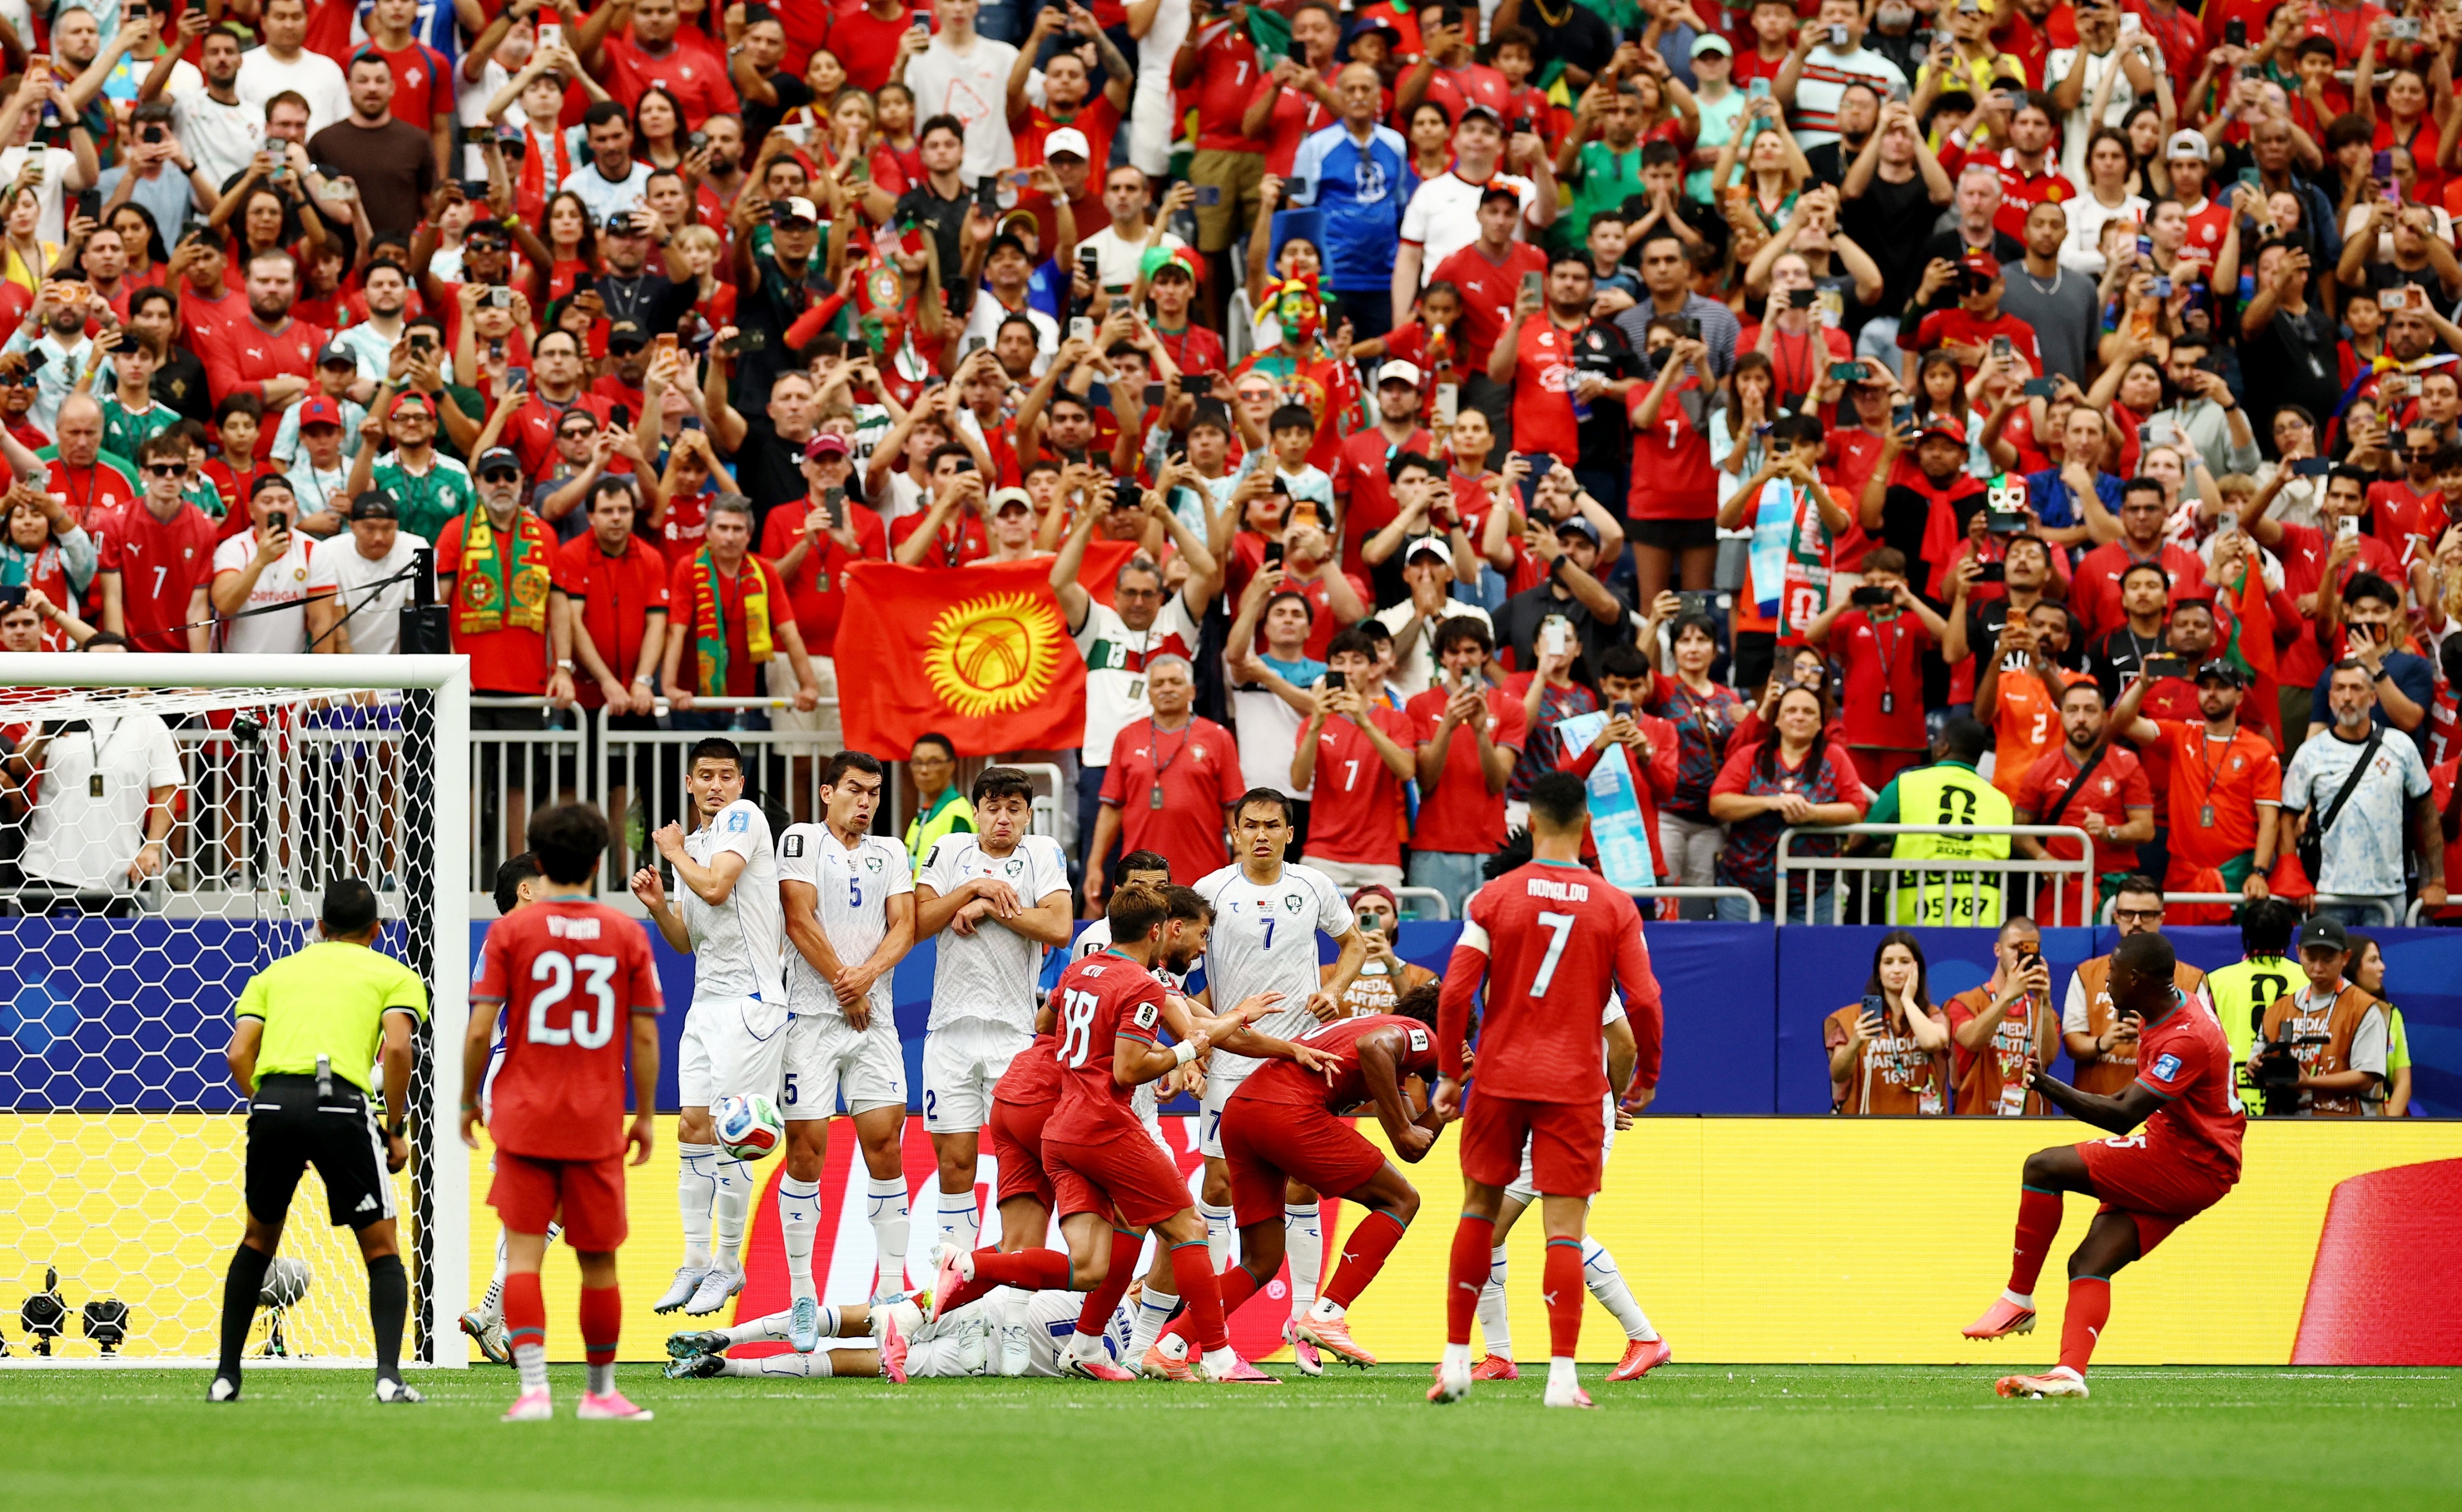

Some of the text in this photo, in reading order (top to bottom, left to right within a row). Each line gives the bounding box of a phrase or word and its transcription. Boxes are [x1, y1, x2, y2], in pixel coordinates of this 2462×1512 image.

[1237, 61, 1249, 85] 7
[1664, 420, 1678, 449] 7
[1465, 514, 1479, 539] 7
[2400, 532, 2417, 566] 7
[153, 566, 167, 599] 7
[1106, 642, 1126, 668] 13
[2031, 714, 2047, 744] 2
[1345, 760, 1360, 792] 7
[868, 858, 881, 867] UFA
[849, 877, 861, 908] 5
[1287, 897, 1300, 907] UFA
[1527, 878, 1589, 903] RONALDO
[1260, 918, 1275, 950] 7
[1529, 911, 1576, 998] 7
[528, 950, 617, 1049] 23
[1057, 987, 1100, 1069] 18
[784, 1074, 798, 1106] 5
[926, 1090, 938, 1122] 2
[1207, 1108, 1221, 1142] 7
